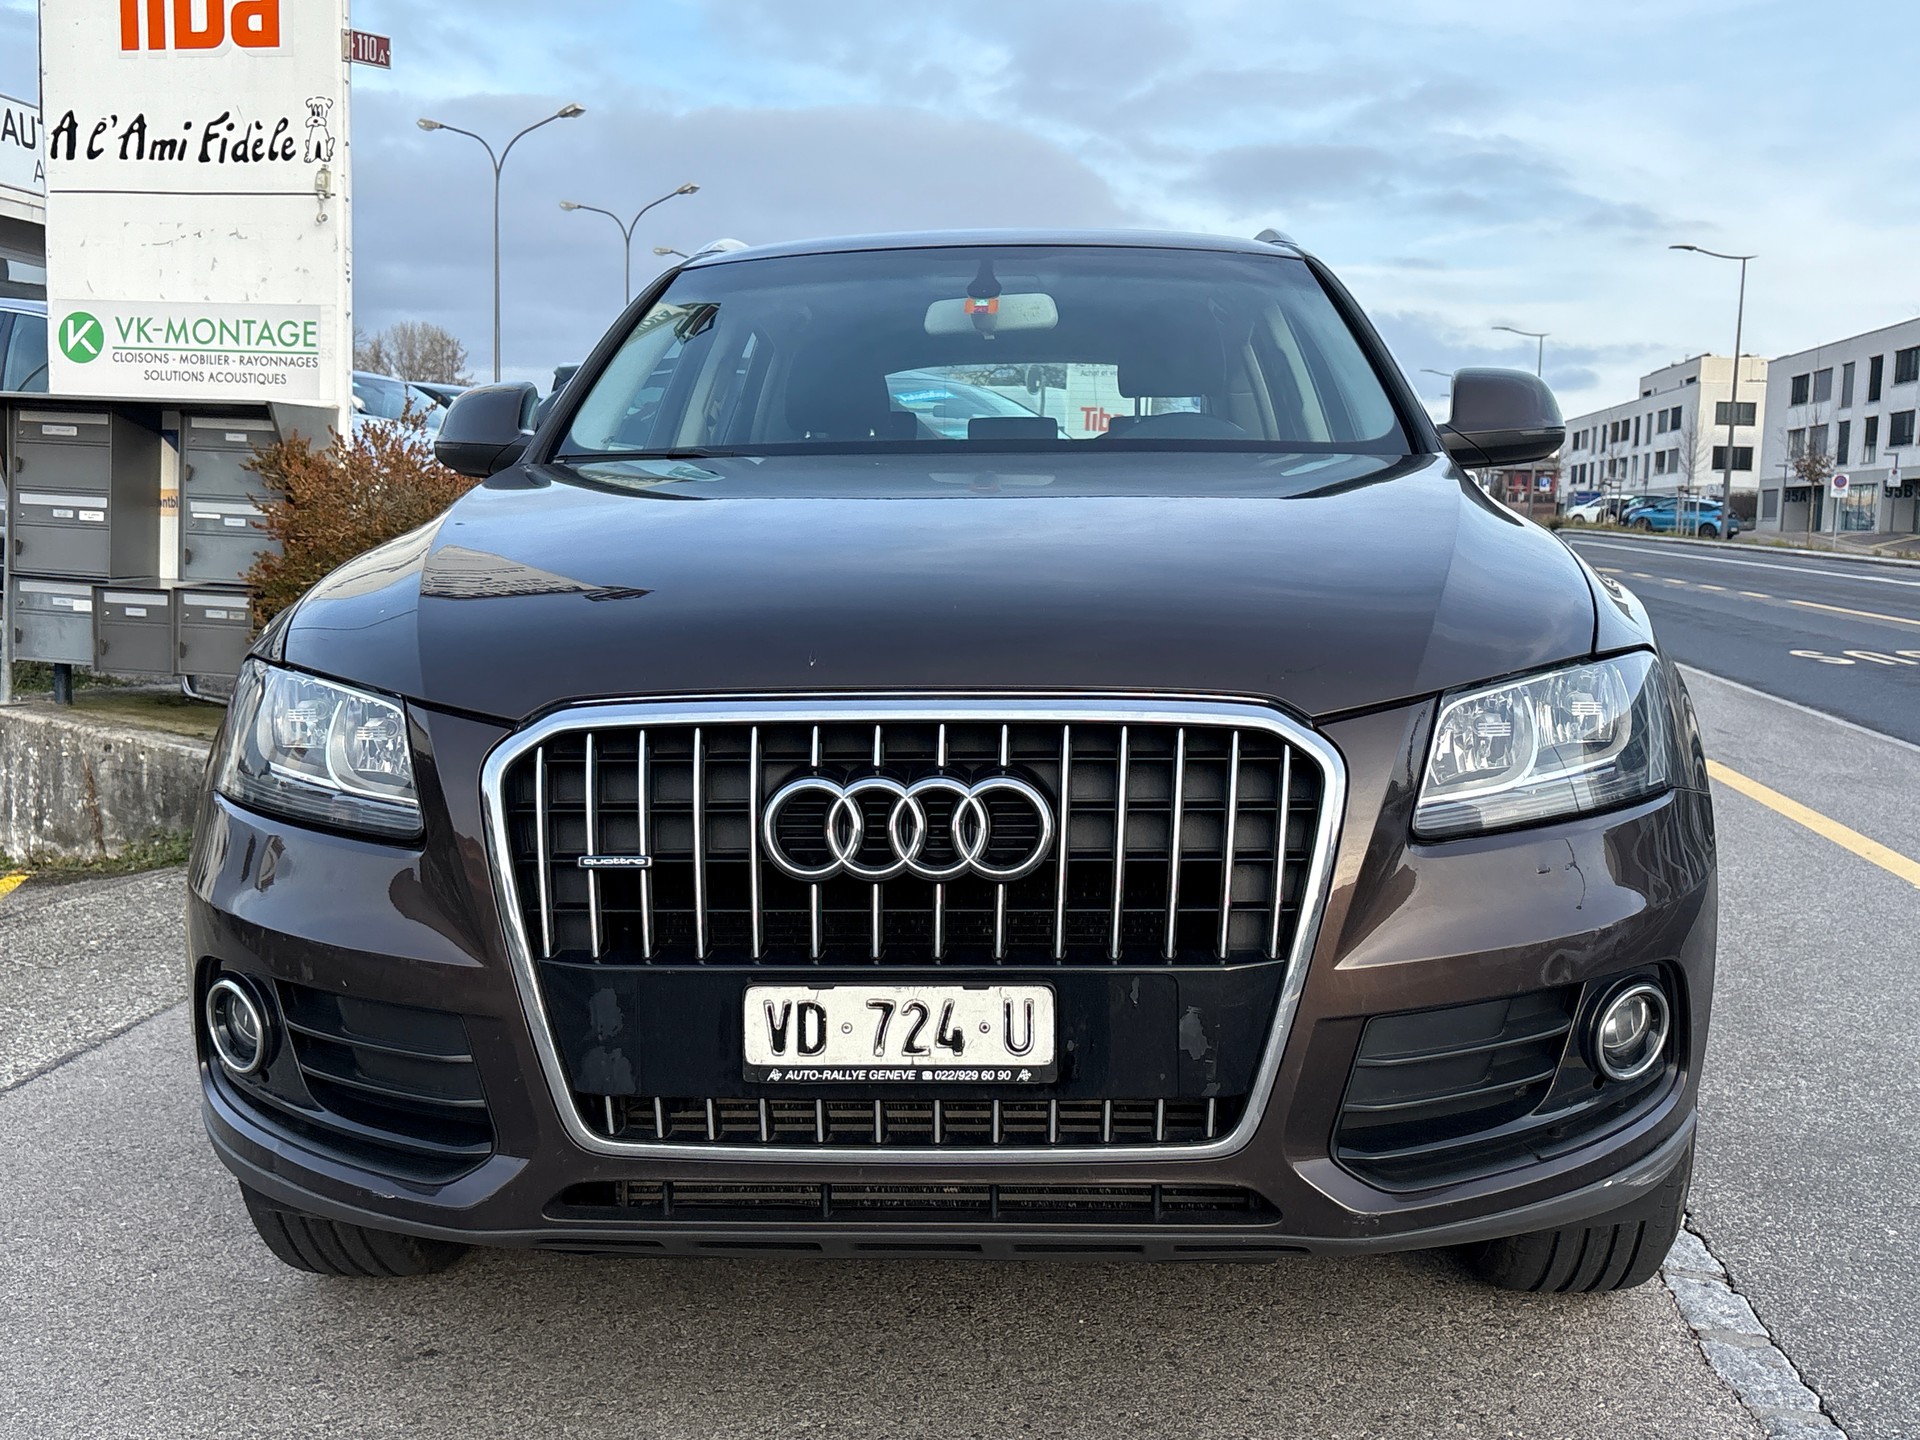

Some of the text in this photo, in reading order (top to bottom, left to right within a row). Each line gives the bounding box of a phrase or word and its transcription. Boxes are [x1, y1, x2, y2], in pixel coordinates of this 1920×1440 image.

[1, 107, 43, 150] AU
[50, 109, 79, 161] A
[197, 110, 297, 164] Fidèle
[114, 315, 318, 348] VK-MONTAGE
[112, 351, 319, 368] CLOISONS MOBILIER RAYONNAGES
[143, 369, 287, 385] SOLUTIONS ACOUSTIQUES
[1081, 407, 1124, 432] Tib
[763, 998, 1035, 1057] VD 724 U
[785, 1069, 1012, 1081] AUTO-RALLYE GENEVE 022/929 60 90
